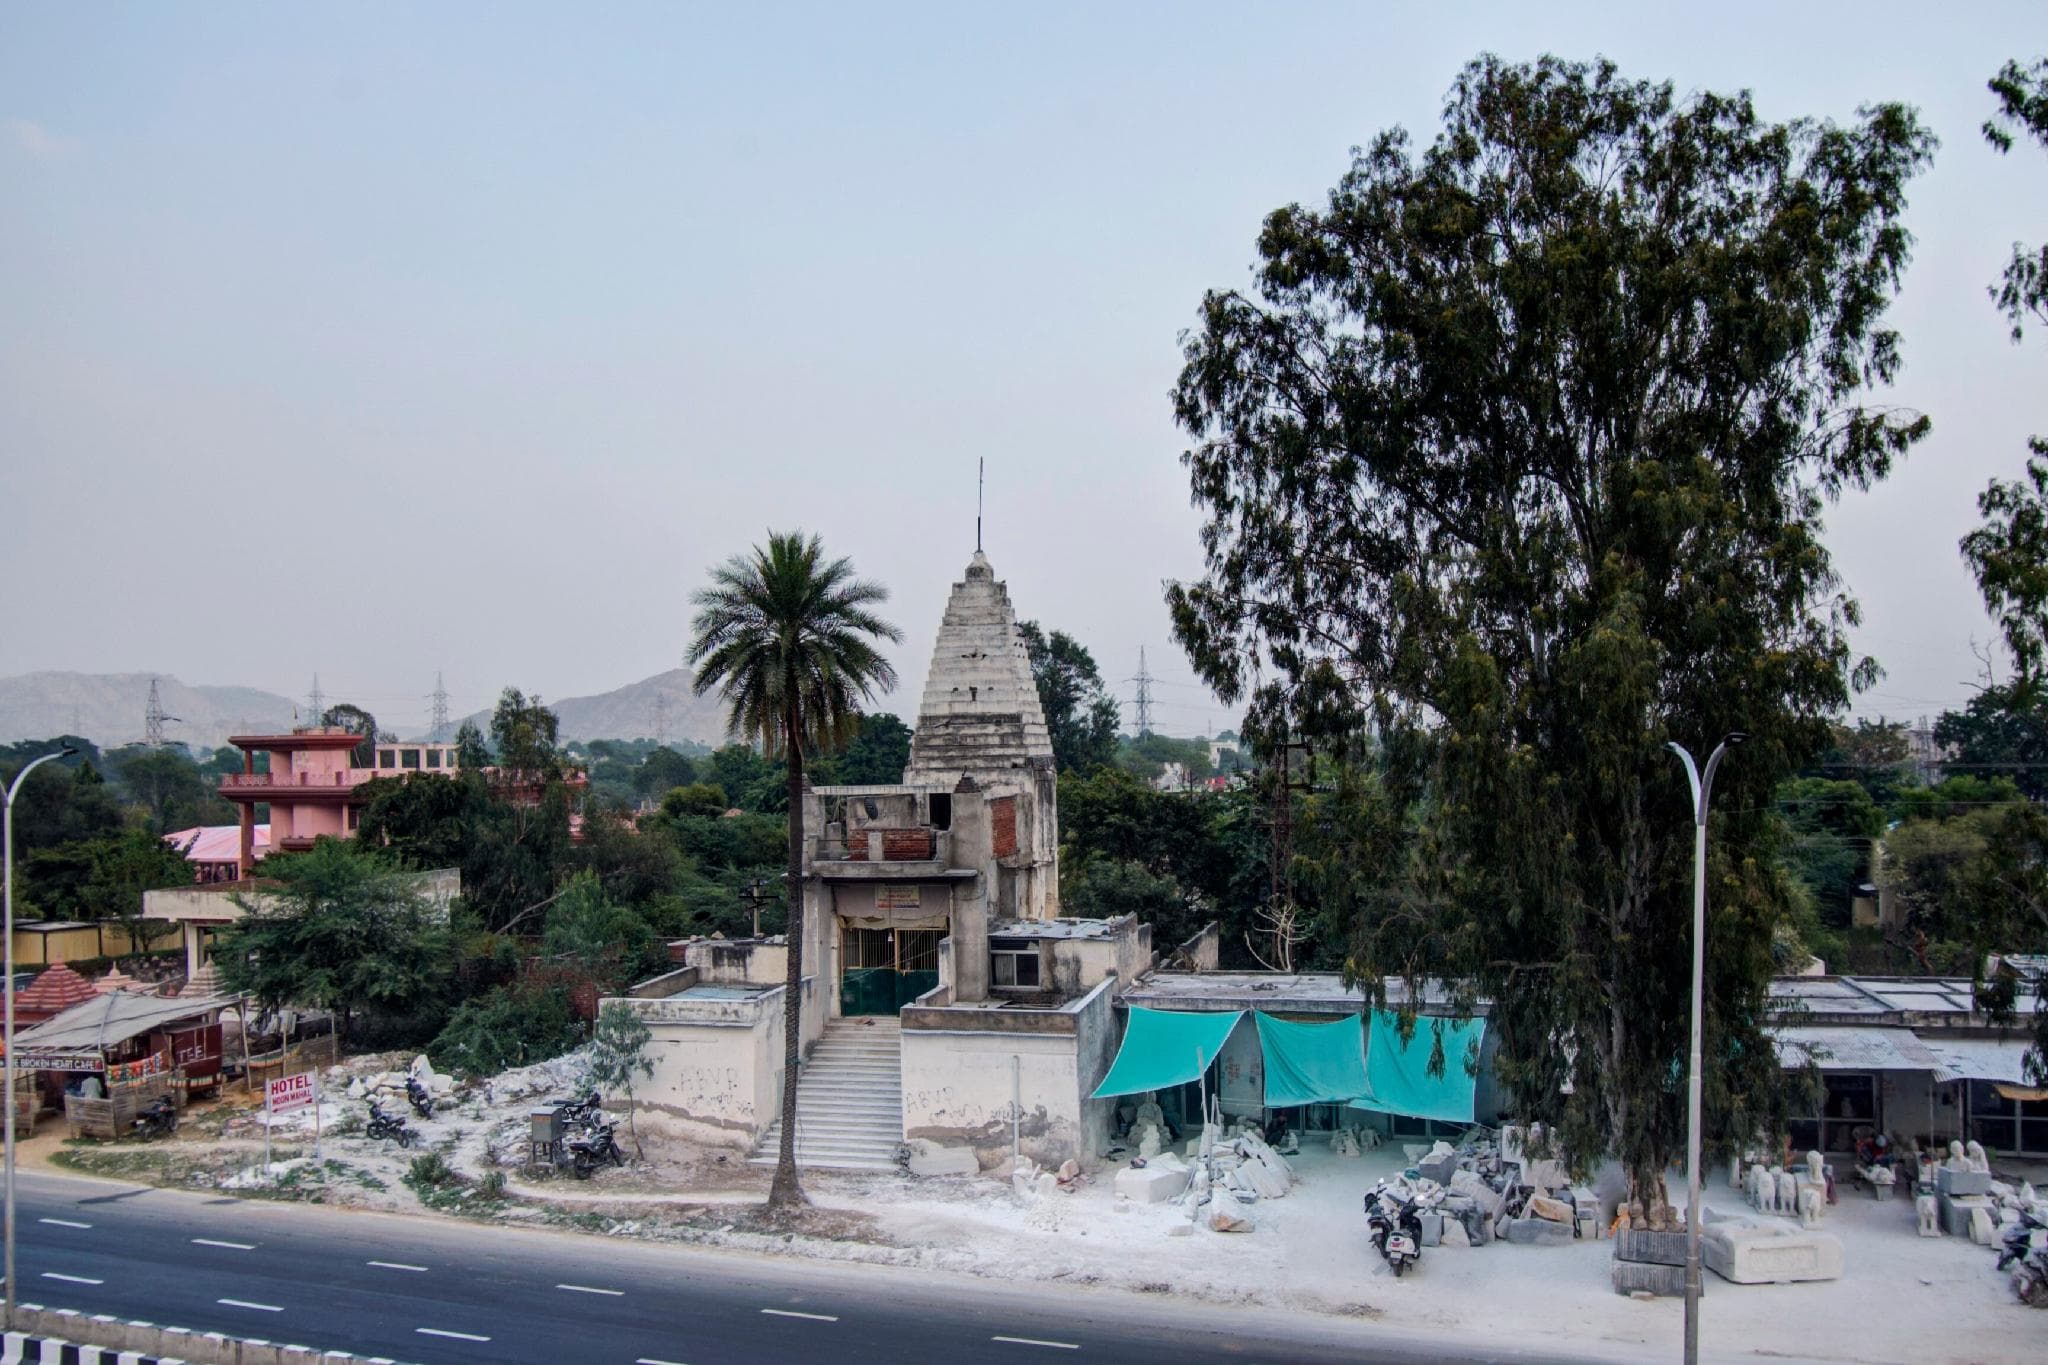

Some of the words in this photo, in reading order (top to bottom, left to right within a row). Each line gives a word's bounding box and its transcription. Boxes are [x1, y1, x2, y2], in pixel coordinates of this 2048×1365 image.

[20, 1058, 50, 1068] BROKEN
[51, 1059, 73, 1069] HEART
[74, 1060, 95, 1070] CAFE
[271, 1075, 312, 1095] HOTEL
